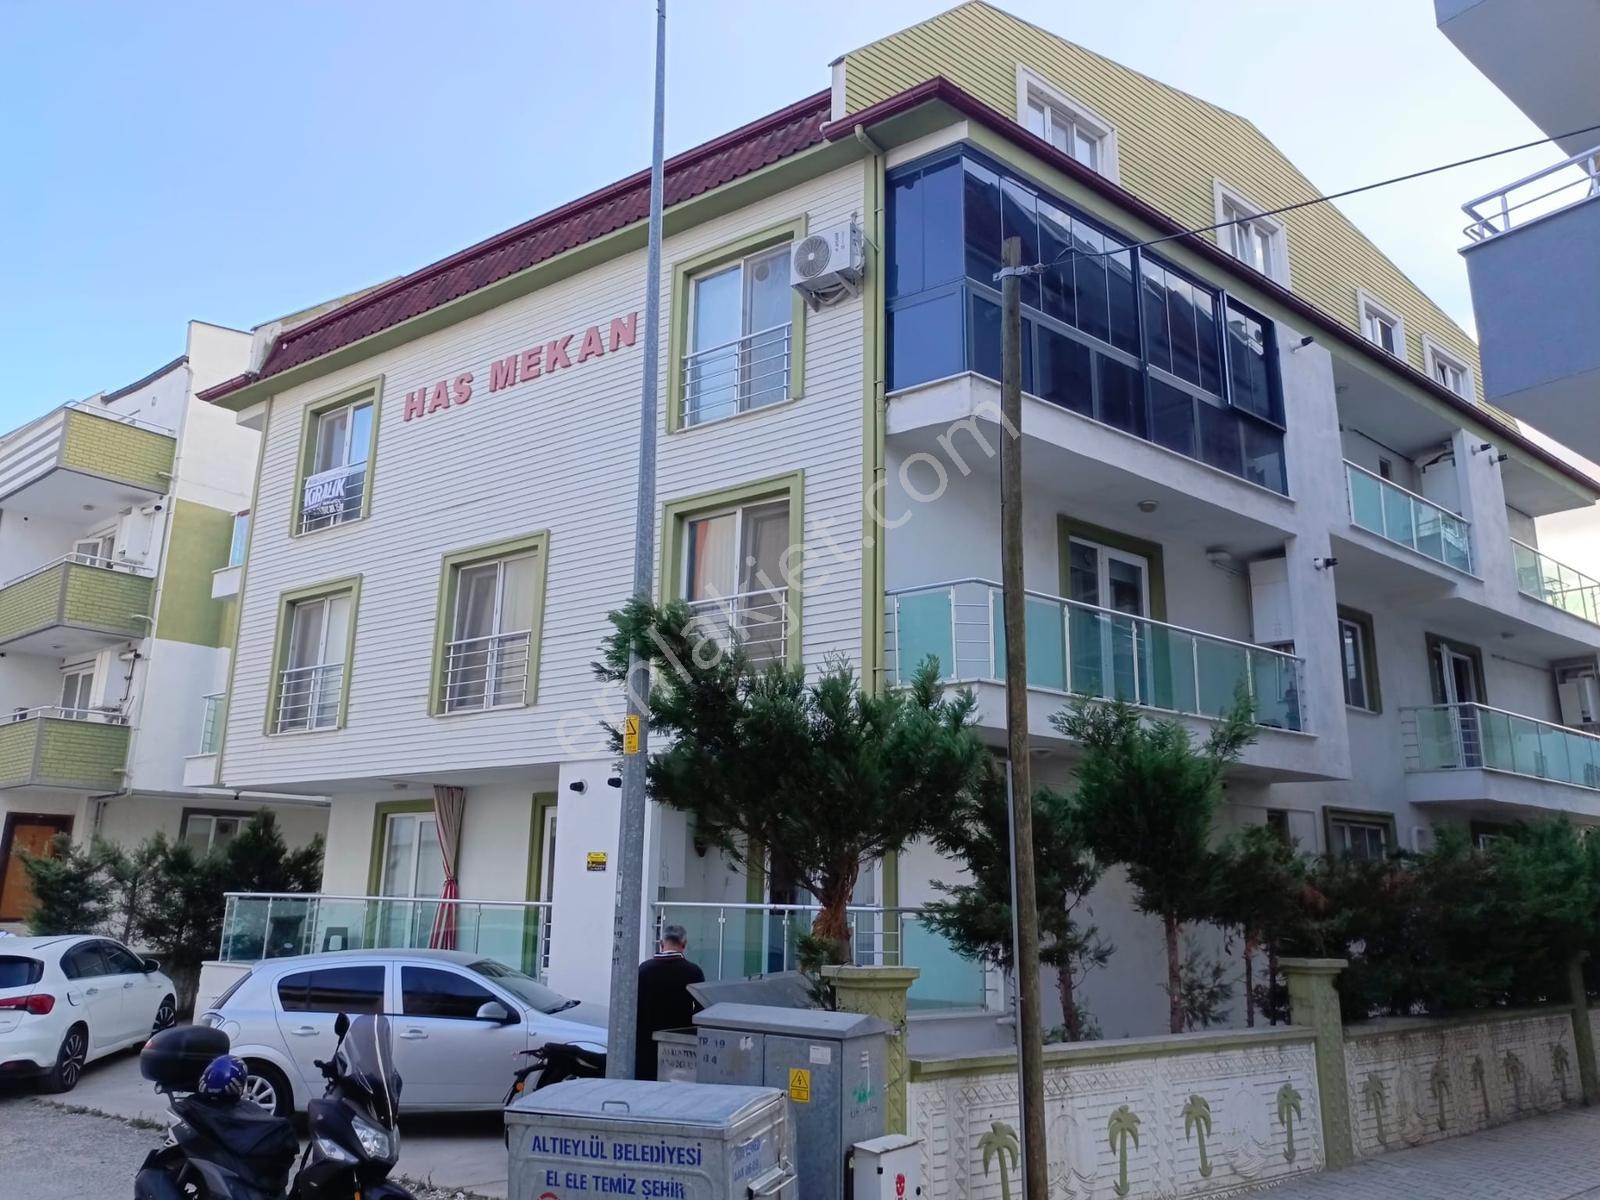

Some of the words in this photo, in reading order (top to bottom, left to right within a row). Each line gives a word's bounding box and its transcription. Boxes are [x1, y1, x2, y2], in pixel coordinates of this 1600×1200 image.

[403, 372, 473, 422] HAS
[489, 311, 637, 392] MEKAN
[532, 1135, 607, 1159] ALTIEYLÜL
[613, 1140, 702, 1167] BELEDİYESİ
[546, 1170, 560, 1187] EL
[565, 1172, 587, 1190] ELE
[592, 1173, 636, 1195] TEMİZ
